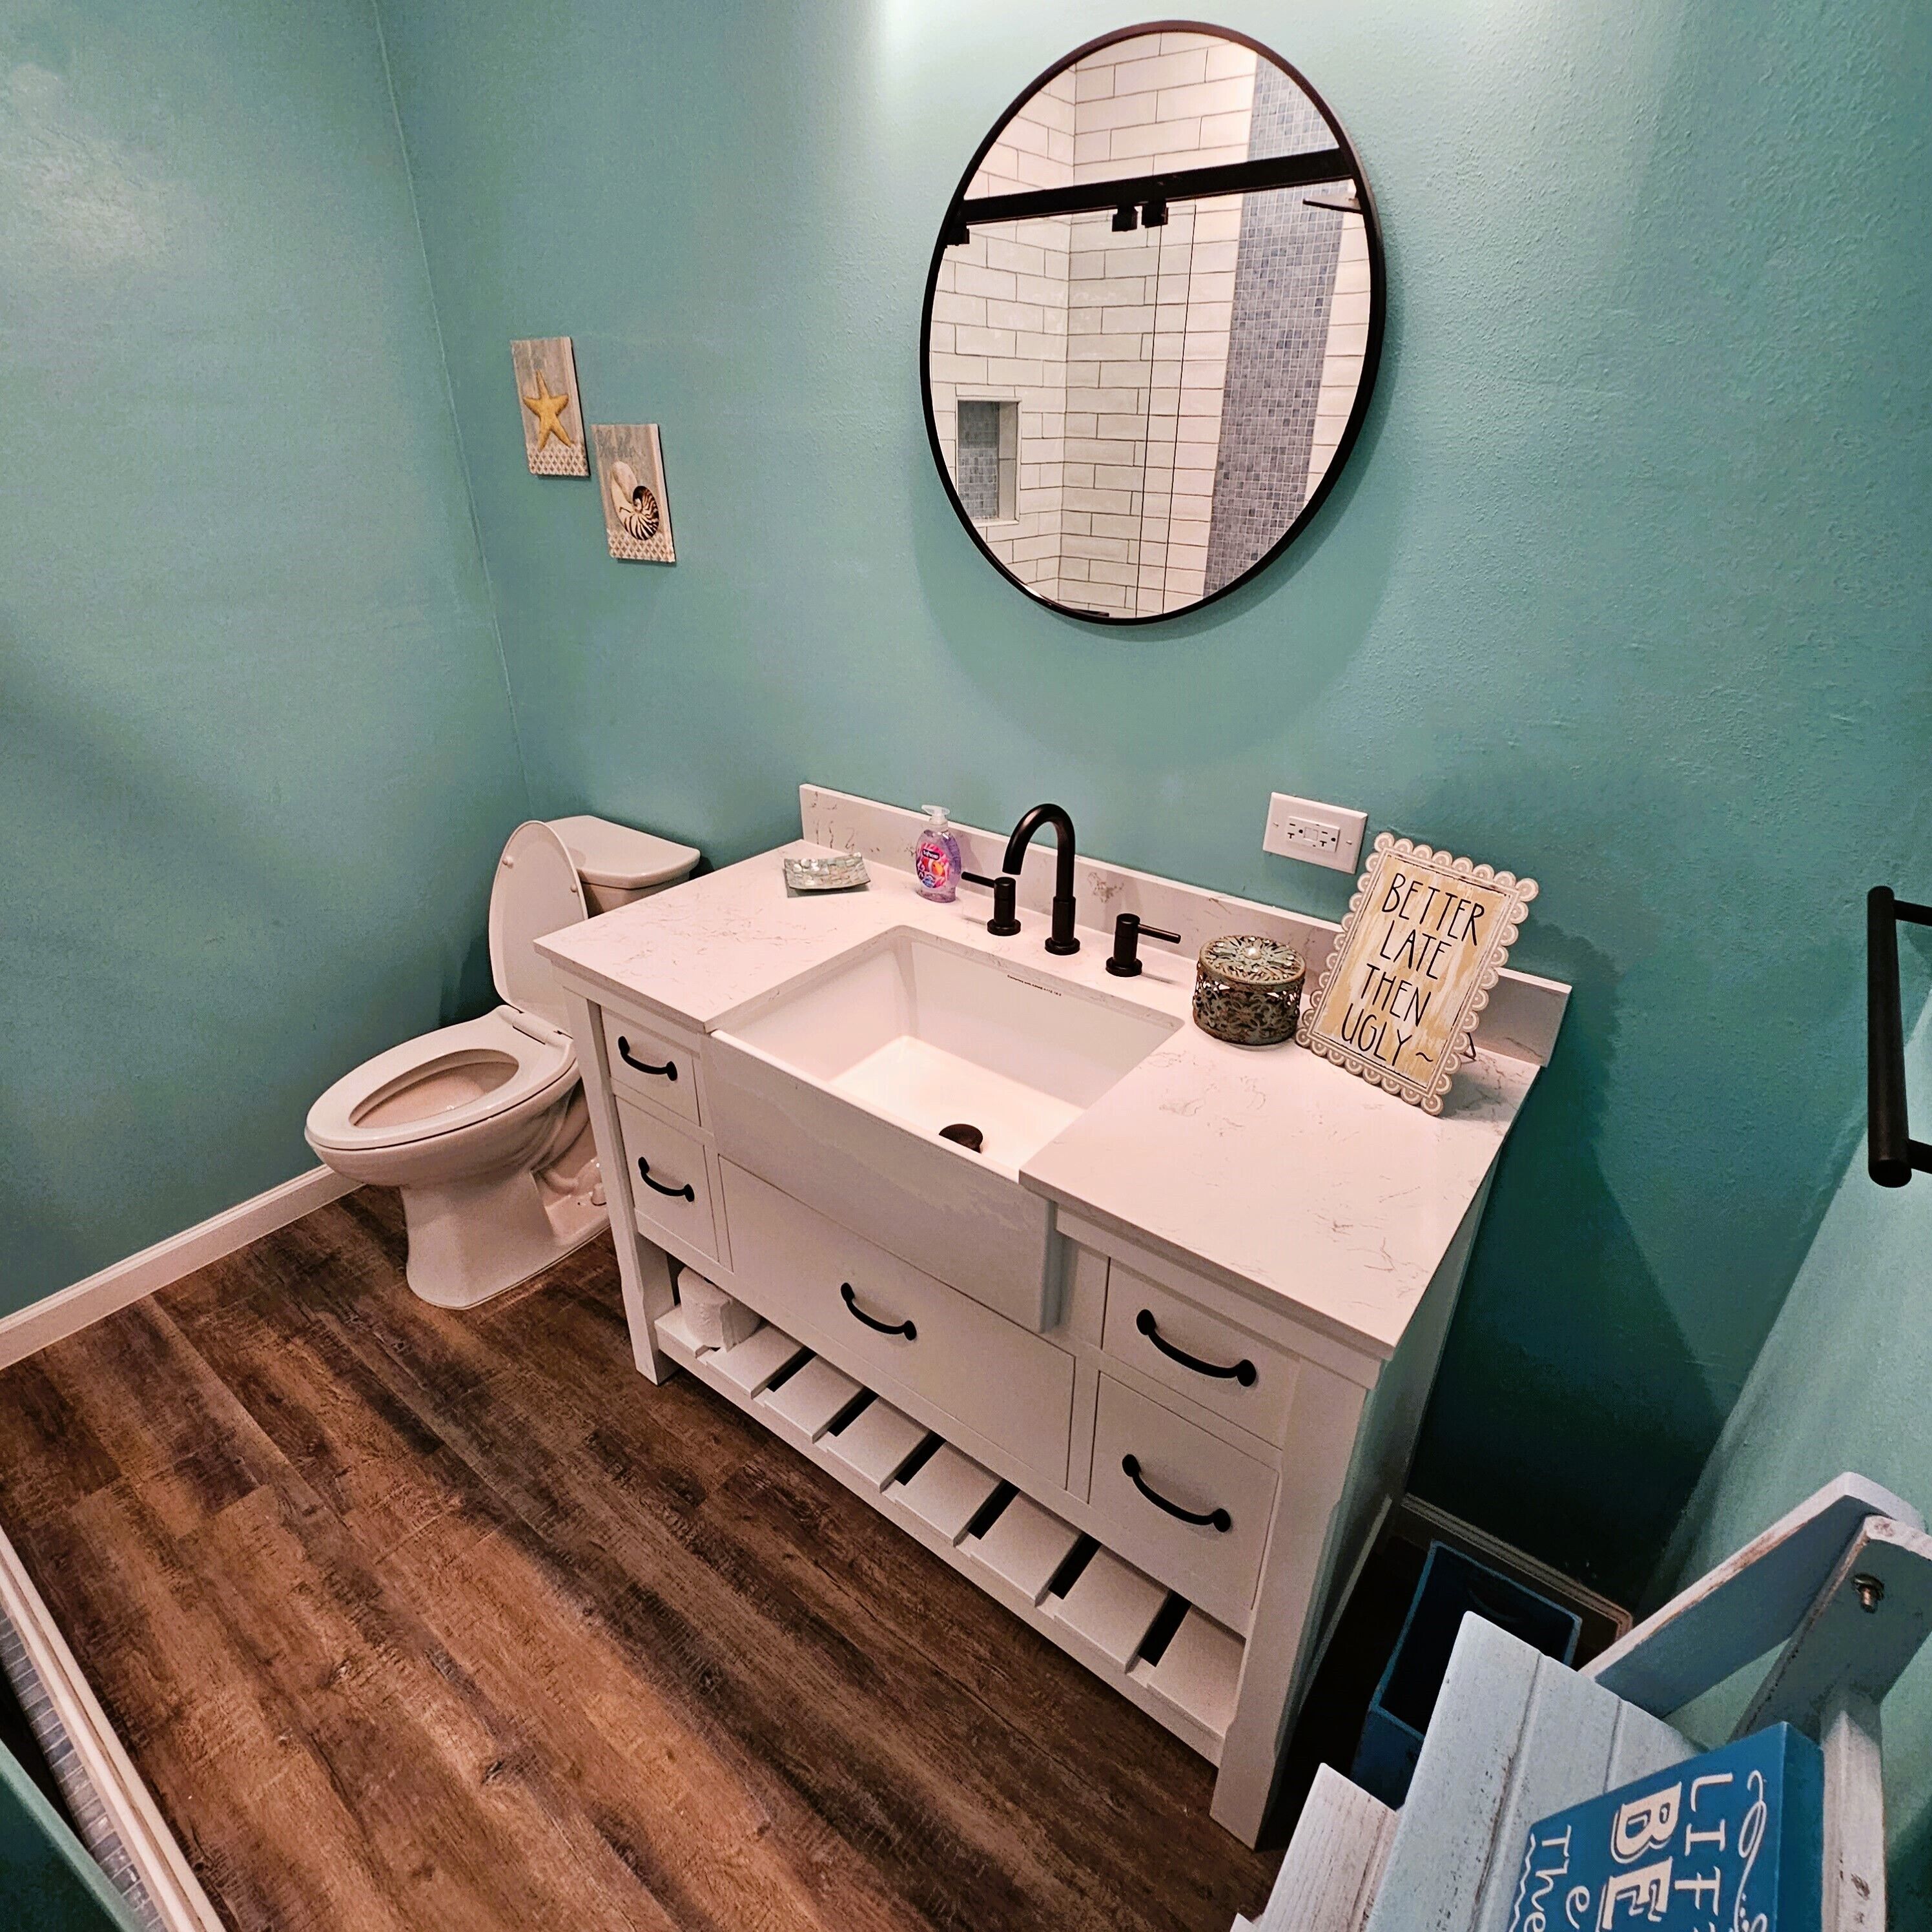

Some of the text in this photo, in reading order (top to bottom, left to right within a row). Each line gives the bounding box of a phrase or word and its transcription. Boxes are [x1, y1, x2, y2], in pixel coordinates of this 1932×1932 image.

[1382, 873, 1485, 945] BETTER
[1380, 920, 1452, 980] LATE
[1361, 963, 1432, 1027] THEN
[1675, 1773, 1734, 1932] LIF
